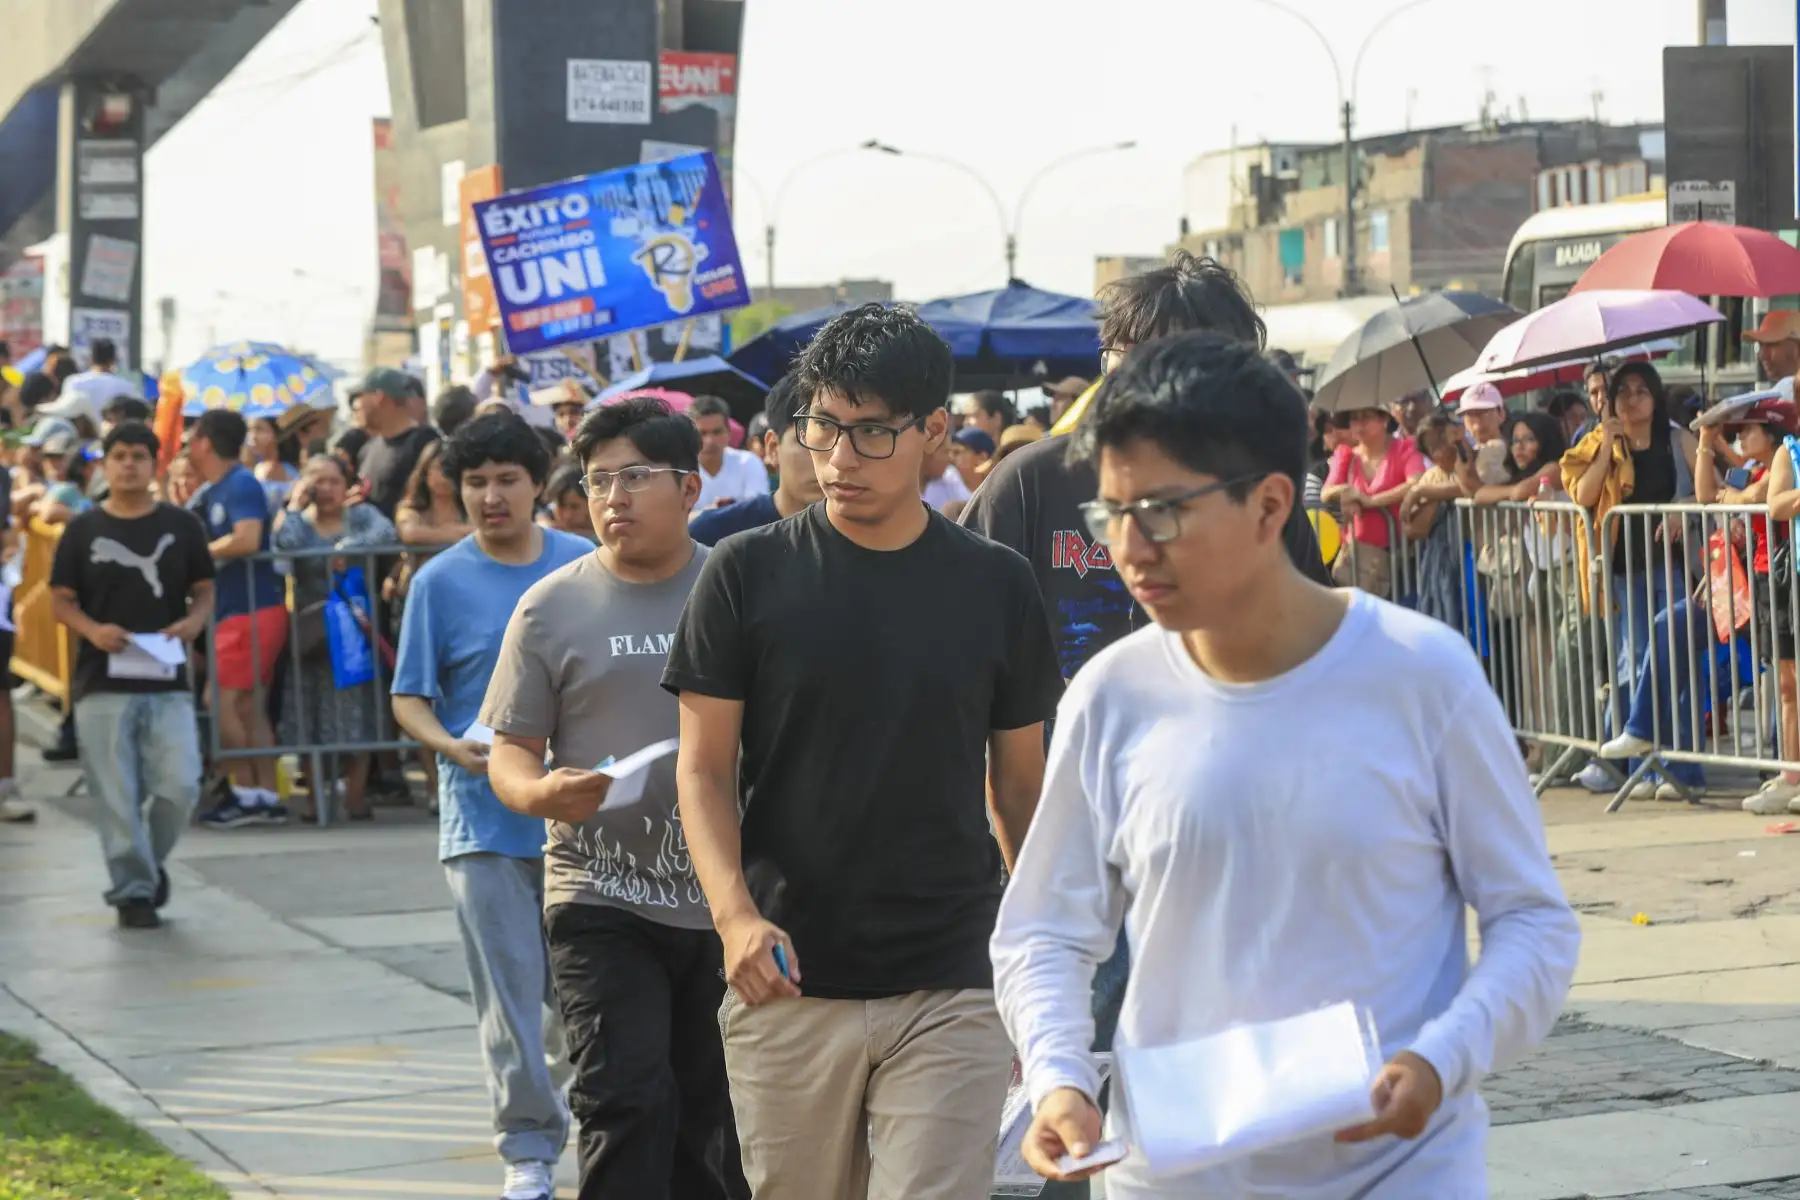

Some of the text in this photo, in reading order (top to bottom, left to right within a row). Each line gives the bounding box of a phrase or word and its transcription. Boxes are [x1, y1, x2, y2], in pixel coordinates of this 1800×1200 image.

[481, 193, 589, 237] ÉXITO
[491, 229, 596, 264] CACHIMBO
[1555, 241, 1602, 267] BAJADA
[497, 246, 607, 305] UNI
[1052, 529, 1117, 579] IRO
[608, 632, 676, 657] FLAM
